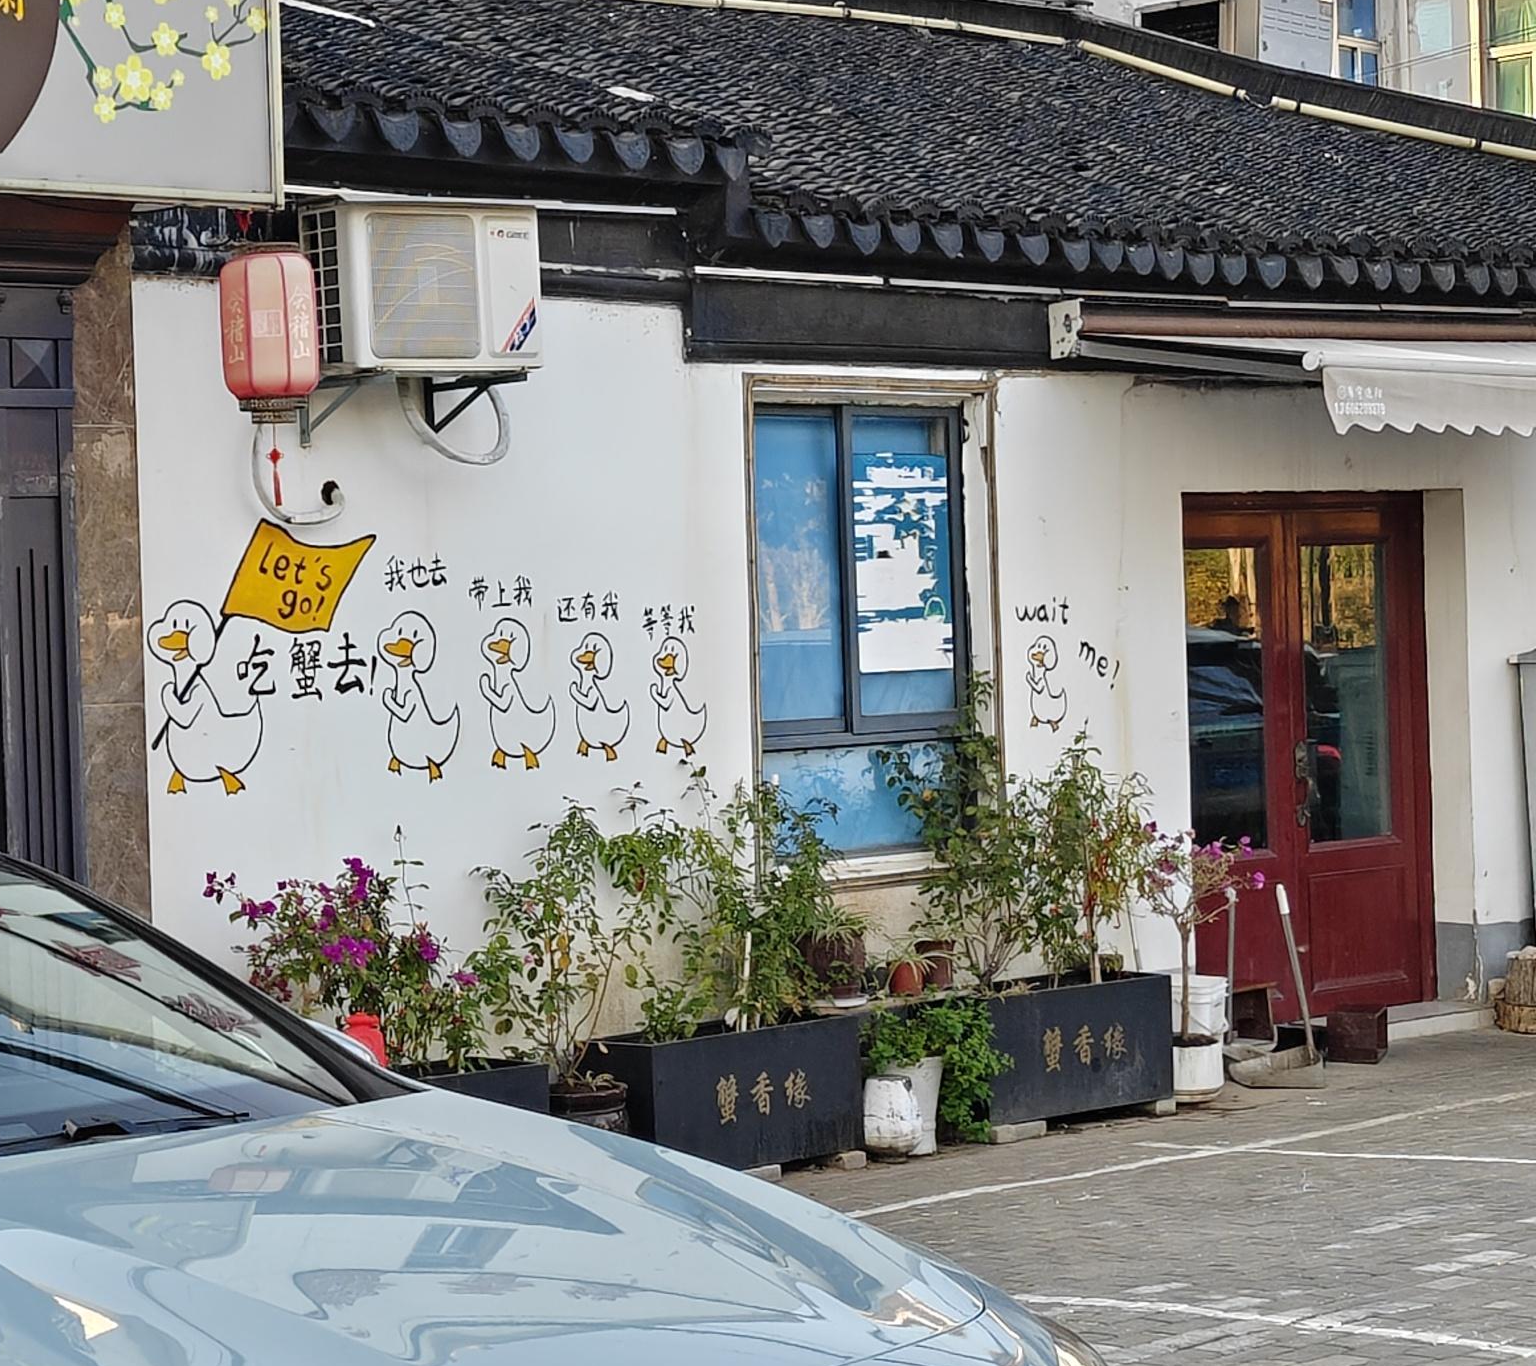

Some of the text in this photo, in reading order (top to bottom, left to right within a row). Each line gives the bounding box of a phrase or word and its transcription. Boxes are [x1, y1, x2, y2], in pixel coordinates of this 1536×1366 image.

[384, 552, 449, 593] 我也去
[277, 588, 326, 623] go!
[467, 574, 534, 612] 带上我
[556, 589, 621, 623] 还有我
[641, 603, 696, 641] 等等我
[1014, 595, 1121, 691] wait me!
[1041, 1021, 1129, 1073] 蟹香缘
[715, 1067, 812, 1126] 蟹香缘
